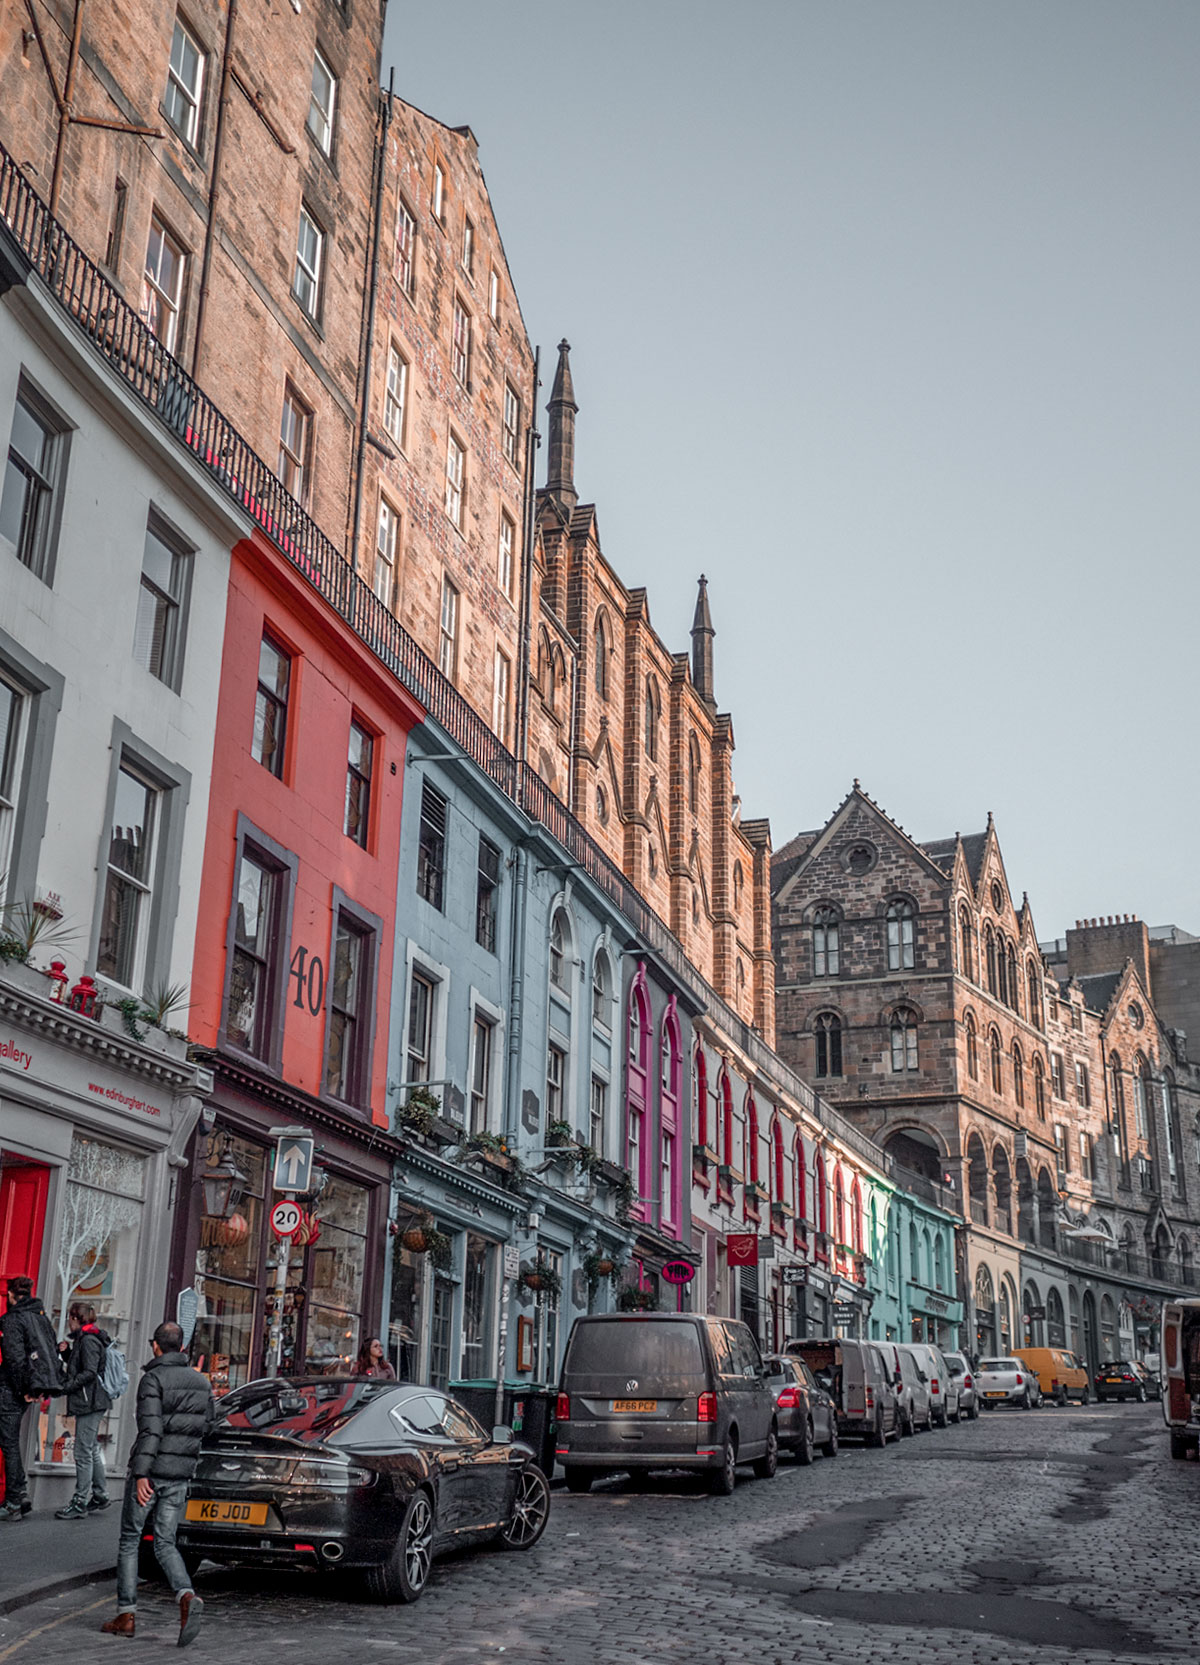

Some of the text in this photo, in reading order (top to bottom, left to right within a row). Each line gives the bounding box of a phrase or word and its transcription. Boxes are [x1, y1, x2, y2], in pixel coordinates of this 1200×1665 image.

[289, 945, 324, 1017] 40
[88, 1082, 161, 1117] www.edinburghart.com
[275, 1210, 298, 1225] 20
[614, 1401, 655, 1410] AF66 PCZ
[200, 1503, 251, 1520] K6 JOD
